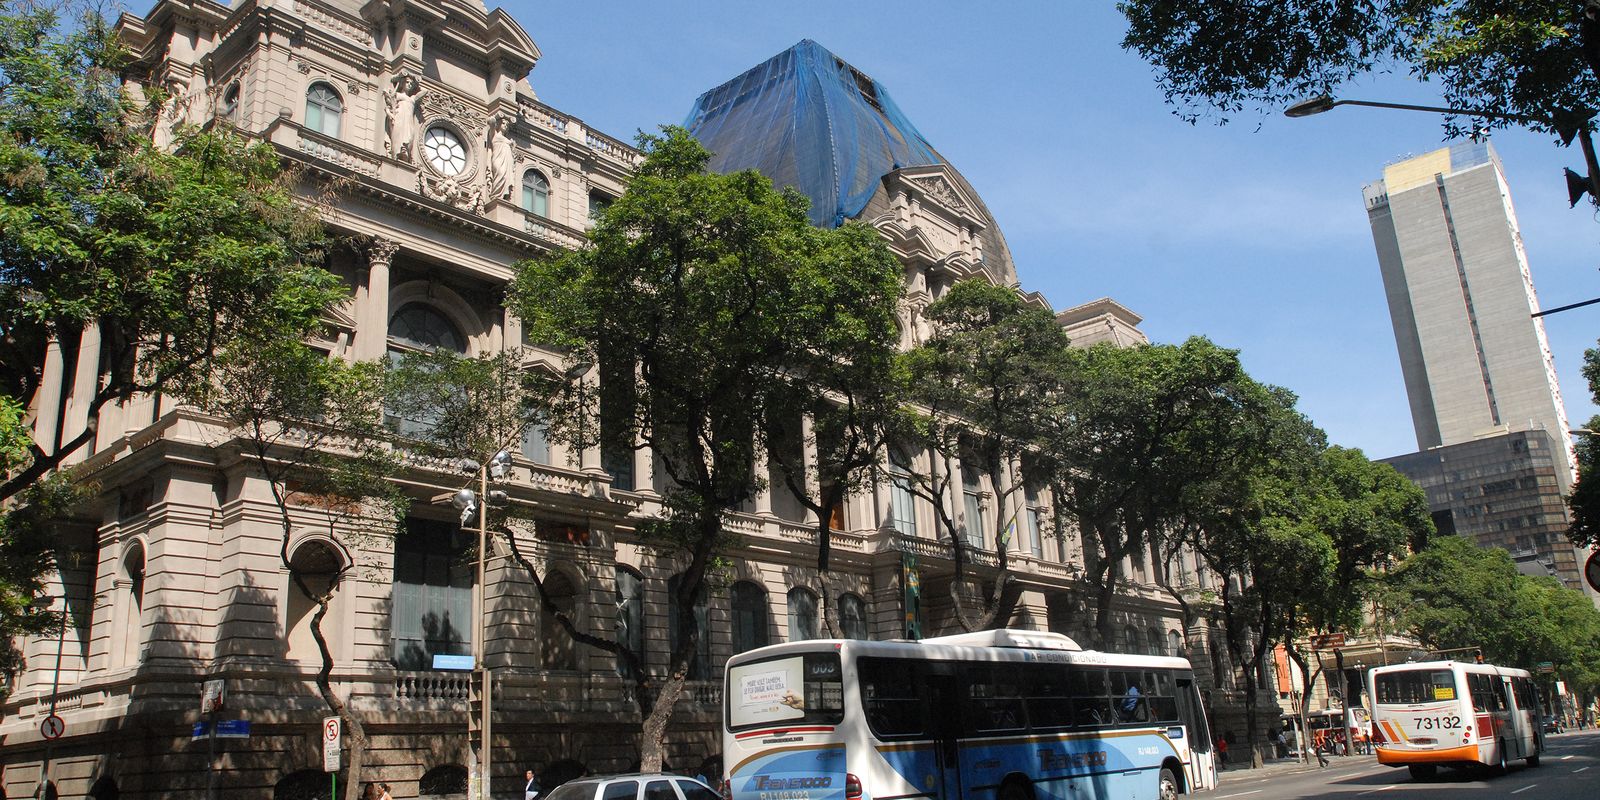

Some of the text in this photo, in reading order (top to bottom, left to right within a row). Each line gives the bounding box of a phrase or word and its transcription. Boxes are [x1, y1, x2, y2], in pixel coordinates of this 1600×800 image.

[1031, 652, 1107, 664] AR CONDICIONADO
[1414, 716, 1461, 730] 73132
